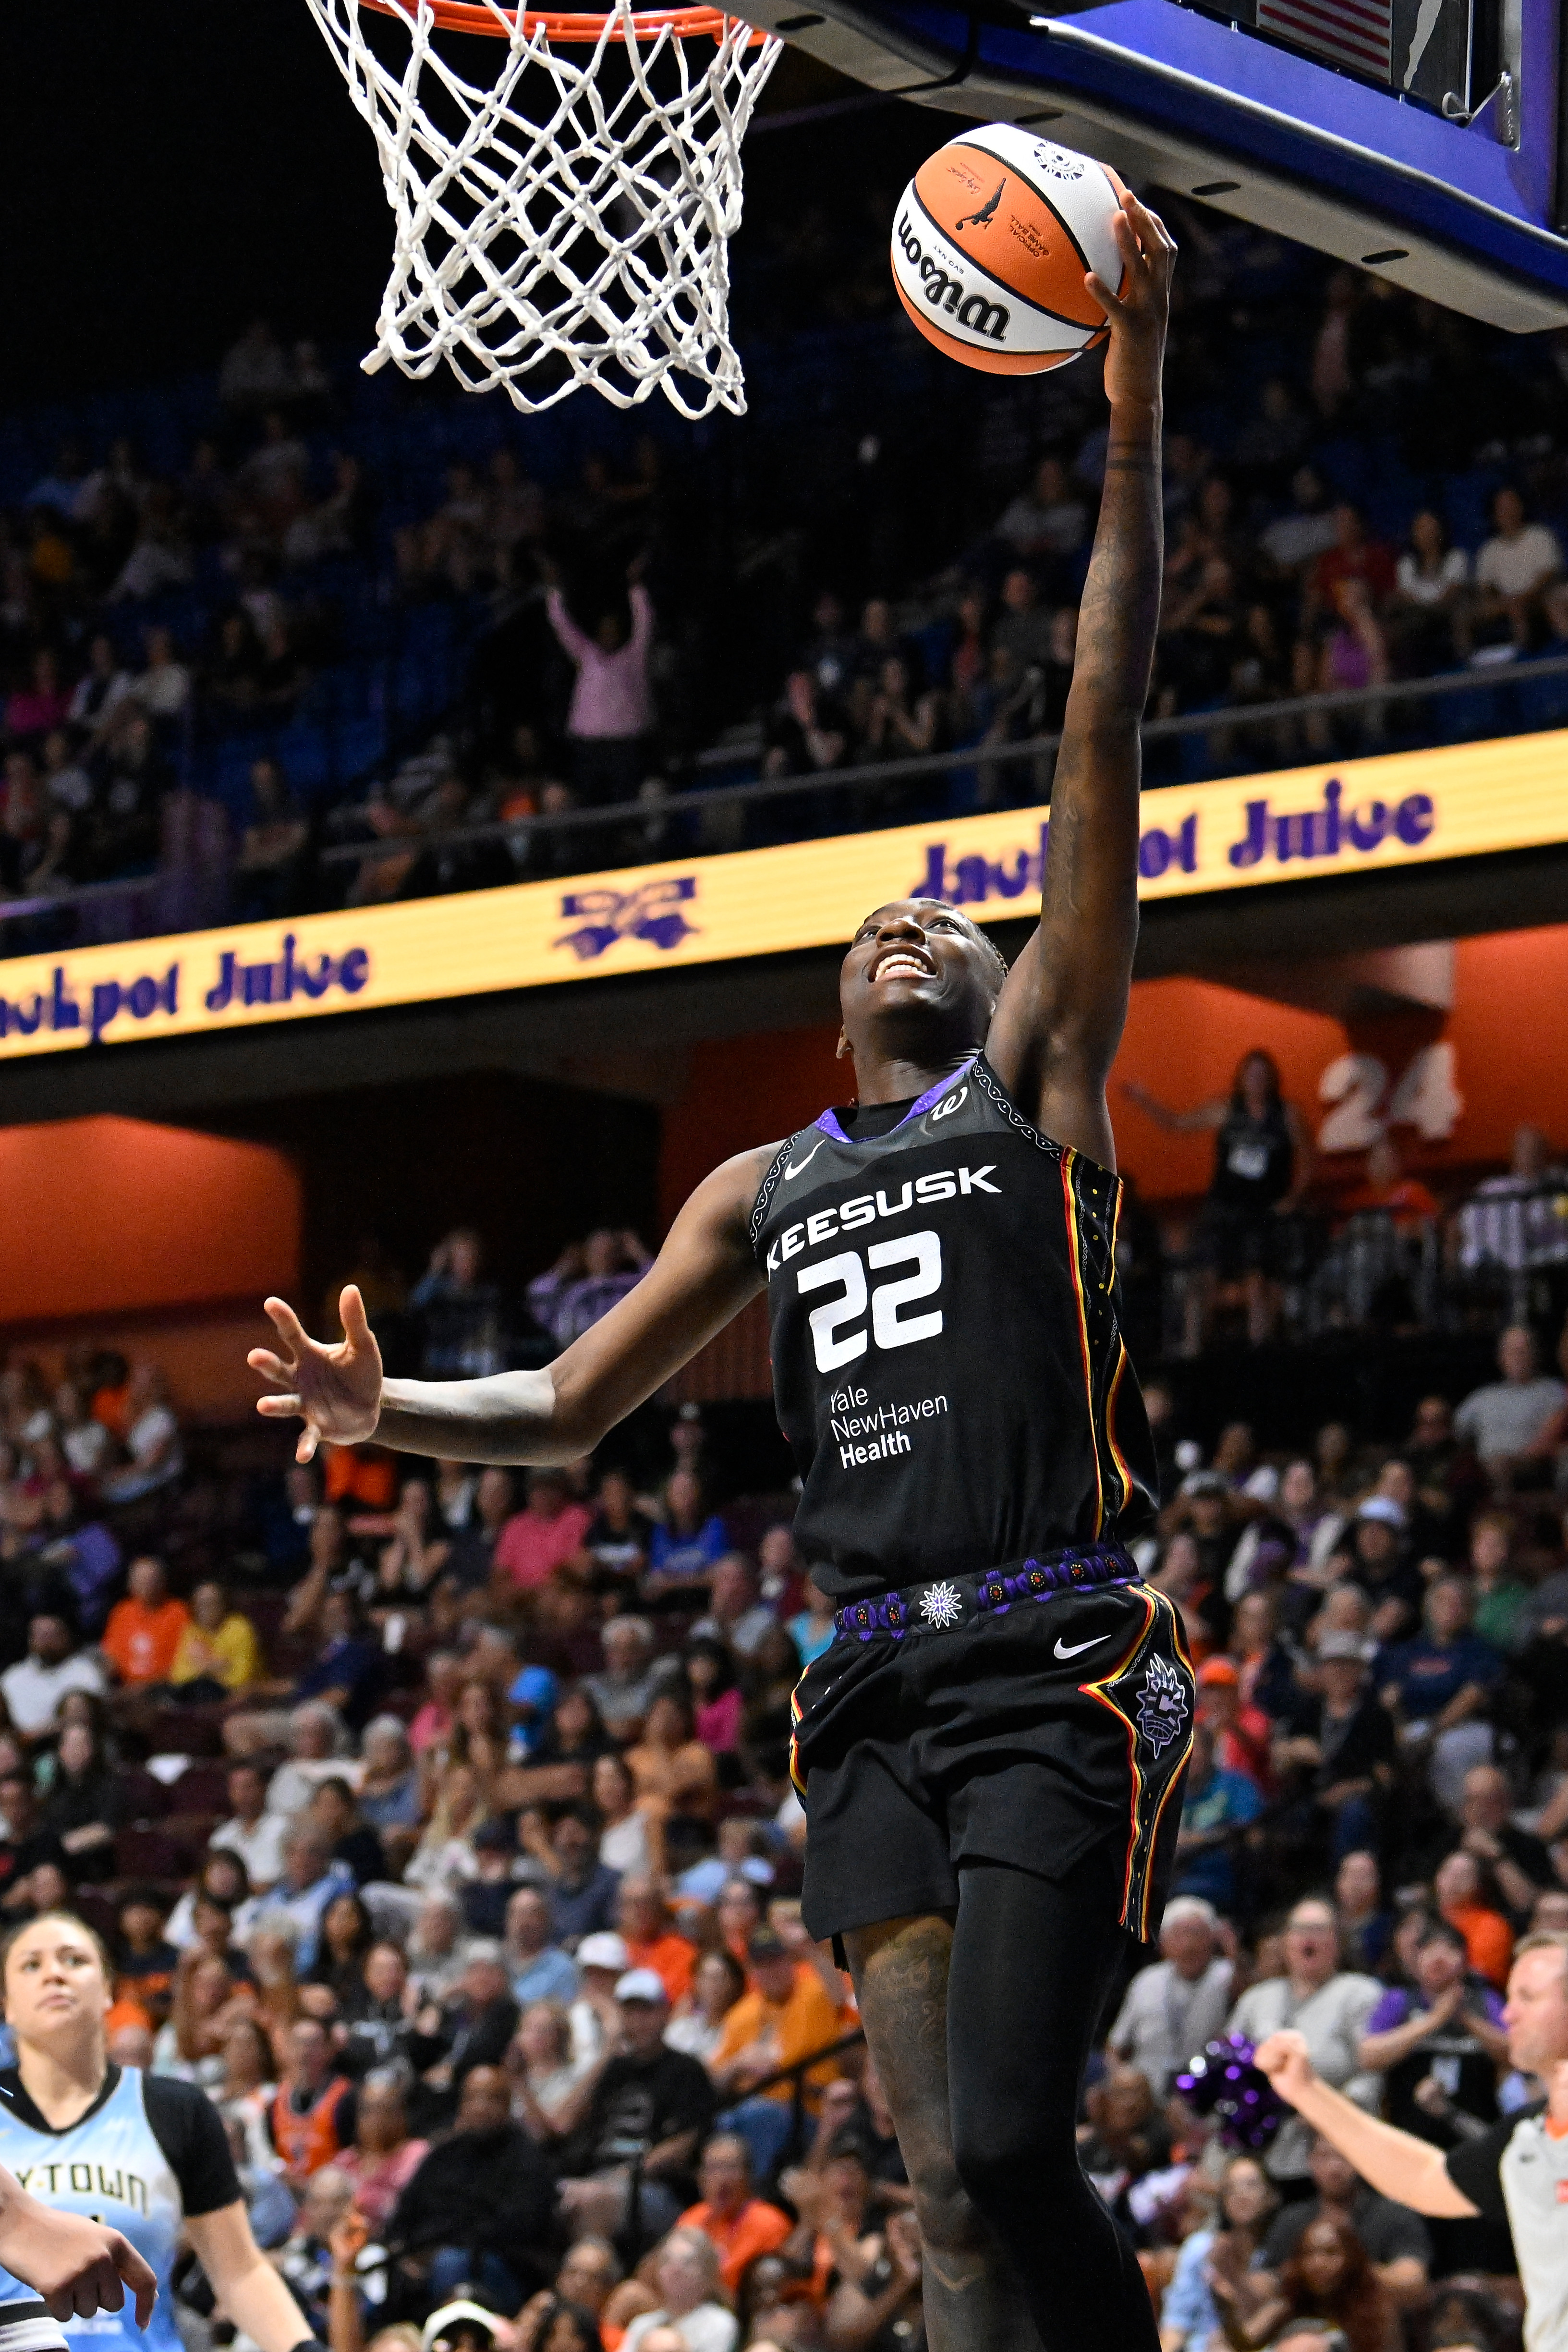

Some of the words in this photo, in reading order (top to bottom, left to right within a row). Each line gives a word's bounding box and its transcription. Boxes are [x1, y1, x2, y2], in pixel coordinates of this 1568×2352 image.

[1009, 224, 1040, 257] OFFICIAL
[1011, 215, 1029, 235] BALL
[1028, 233, 1049, 256] GAME
[933, 245, 947, 259] NXT
[948, 260, 964, 274] EVO
[899, 208, 1010, 342] Wilson
[911, 812, 1197, 905] Jacot
[1228, 778, 1434, 867] Juice
[0, 963, 179, 1046] ckpot
[205, 933, 369, 1011] Juice
[1317, 1040, 1463, 1151] 24
[766, 1165, 1002, 1282] KEESUSK
[797, 1230, 943, 1373] 22
[830, 1385, 868, 1414] Yale
[839, 1430, 911, 1469] Health
